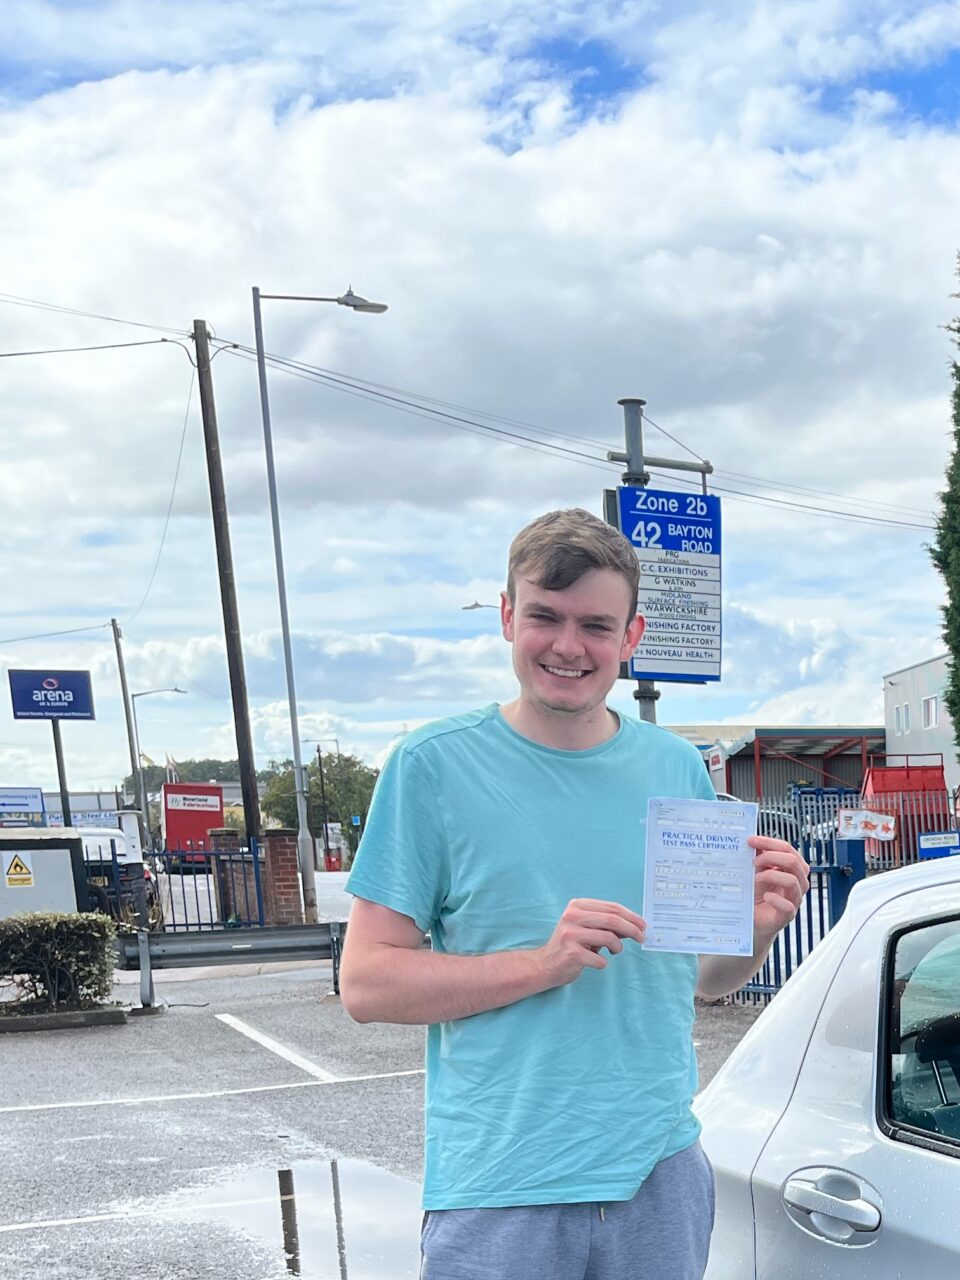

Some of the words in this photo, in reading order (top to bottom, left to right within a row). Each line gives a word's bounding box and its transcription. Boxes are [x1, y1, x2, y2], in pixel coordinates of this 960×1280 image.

[635, 491, 679, 513] Zone
[686, 497, 708, 516] 2b
[631, 521, 663, 549] 42
[668, 523, 713, 539] BAYTON
[681, 540, 713, 554] ROAD
[665, 551, 680, 559] PRG
[658, 565, 708, 577] EXHIBITIONS
[654, 577, 660, 585] G
[663, 577, 697, 588] WATKINS
[647, 597, 676, 605] SURFACE
[678, 599, 709, 607] FINISHING
[660, 592, 692, 600] MIDLAND
[644, 604, 708, 616] WARWICKSHIRE
[645, 621, 679, 630] NISHING
[681, 623, 716, 632] FACTORY
[643, 634, 680, 644] FINISHING
[681, 636, 714, 646] FACTORY
[645, 648, 683, 658] NOUVEAU
[685, 650, 713, 659] HEALTH
[32, 690, 74, 702] arena
[662, 831, 704, 842] PRACTICAL
[706, 834, 740, 844] DRIVING
[662, 839, 677, 847] TEST
[679, 840, 696, 848] PASS
[697, 841, 740, 851] CERTIFICATE
